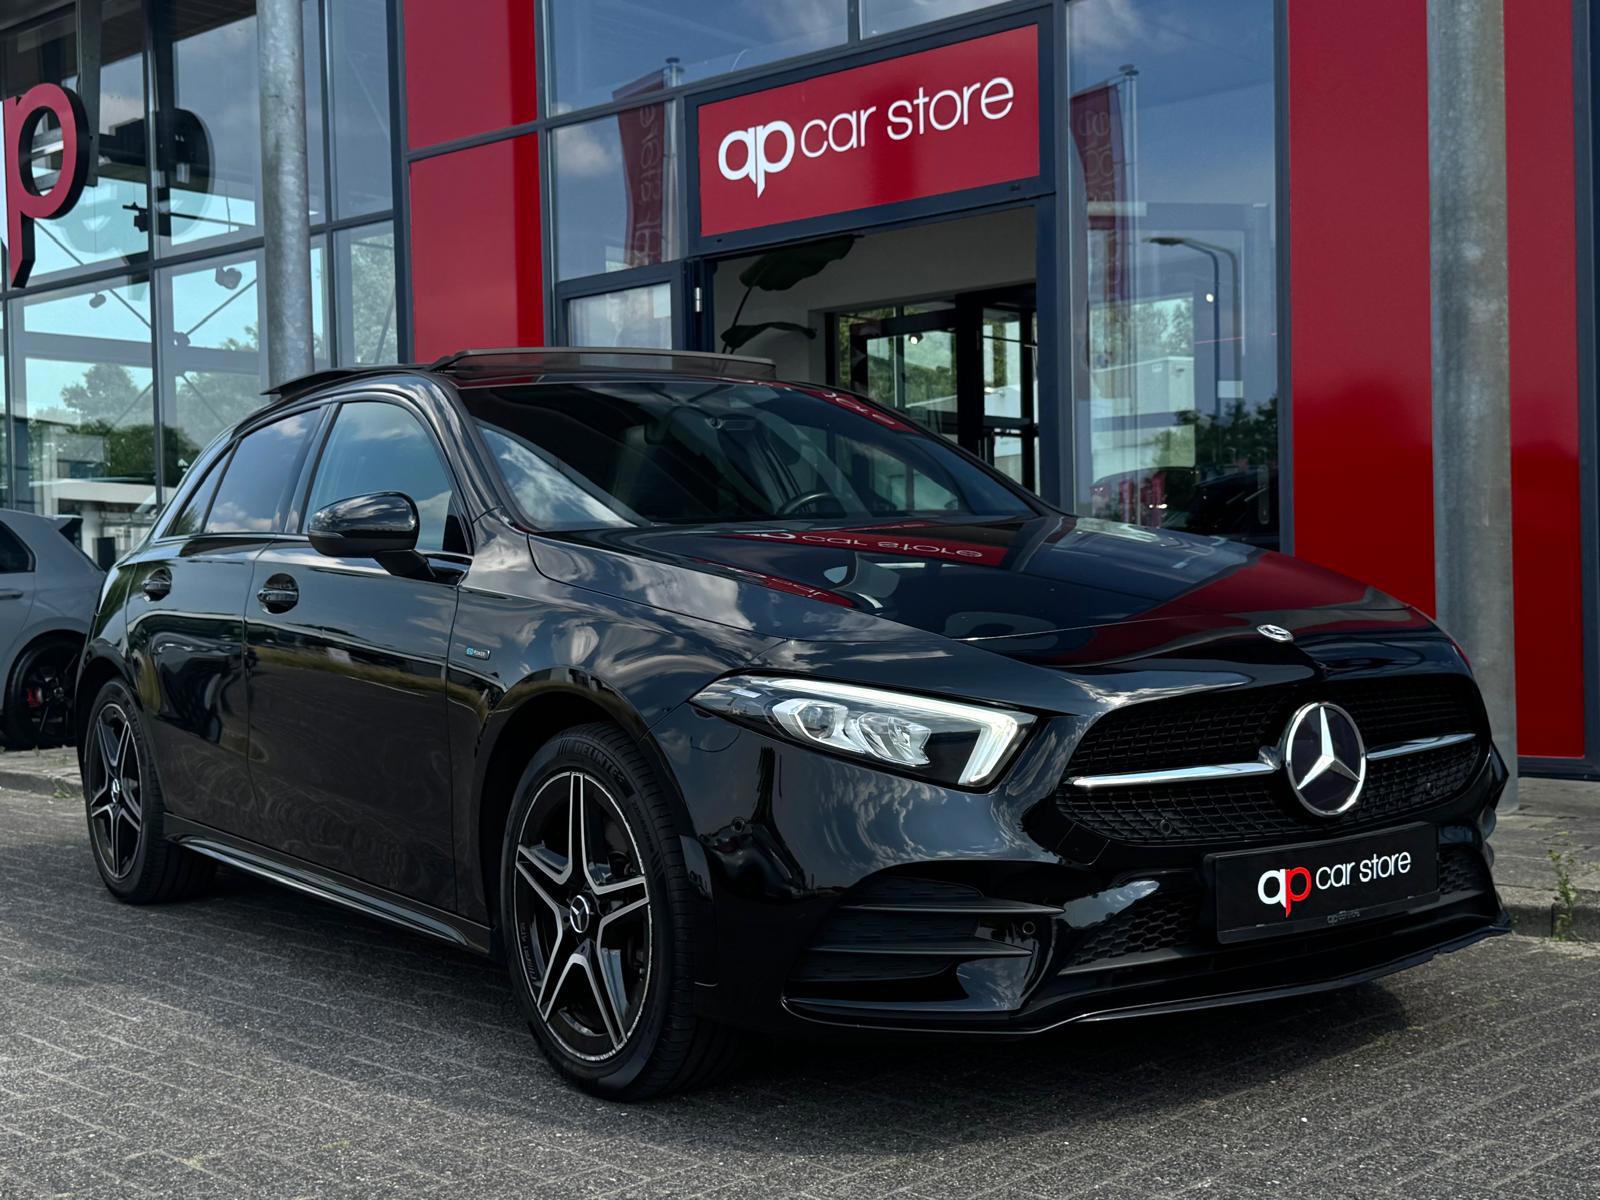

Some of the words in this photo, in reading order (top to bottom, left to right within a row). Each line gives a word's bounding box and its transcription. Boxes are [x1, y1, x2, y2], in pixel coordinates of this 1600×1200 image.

[0, 82, 84, 287] p
[718, 120, 795, 198] ap
[801, 106, 876, 158] car
[887, 76, 1015, 140] store
[1257, 866, 1312, 918] ap
[1315, 861, 1355, 890] car
[1359, 851, 1411, 883] store
